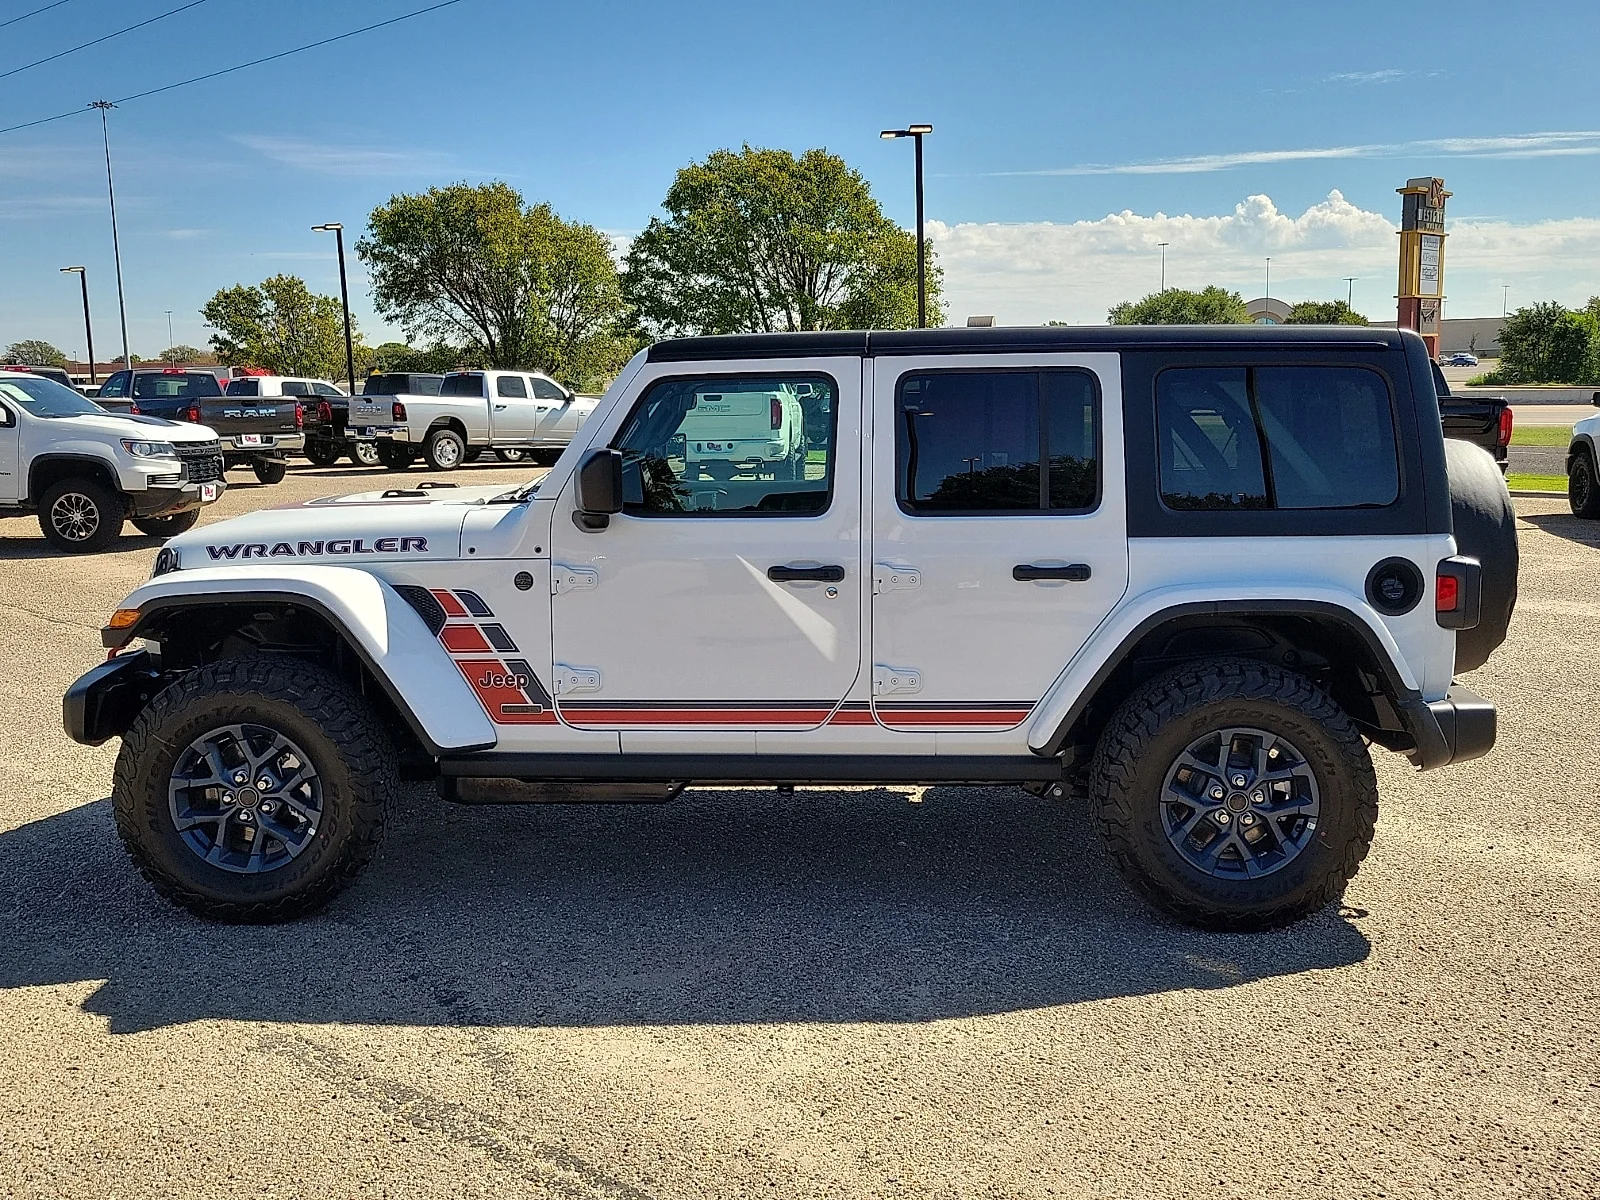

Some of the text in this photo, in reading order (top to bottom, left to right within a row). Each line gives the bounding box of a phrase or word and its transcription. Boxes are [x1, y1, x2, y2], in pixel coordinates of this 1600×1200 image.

[223, 408, 277, 418] RAM
[697, 405, 731, 413] GMC
[205, 535, 429, 561] WRANGLER
[478, 670, 530, 691] Jeep
